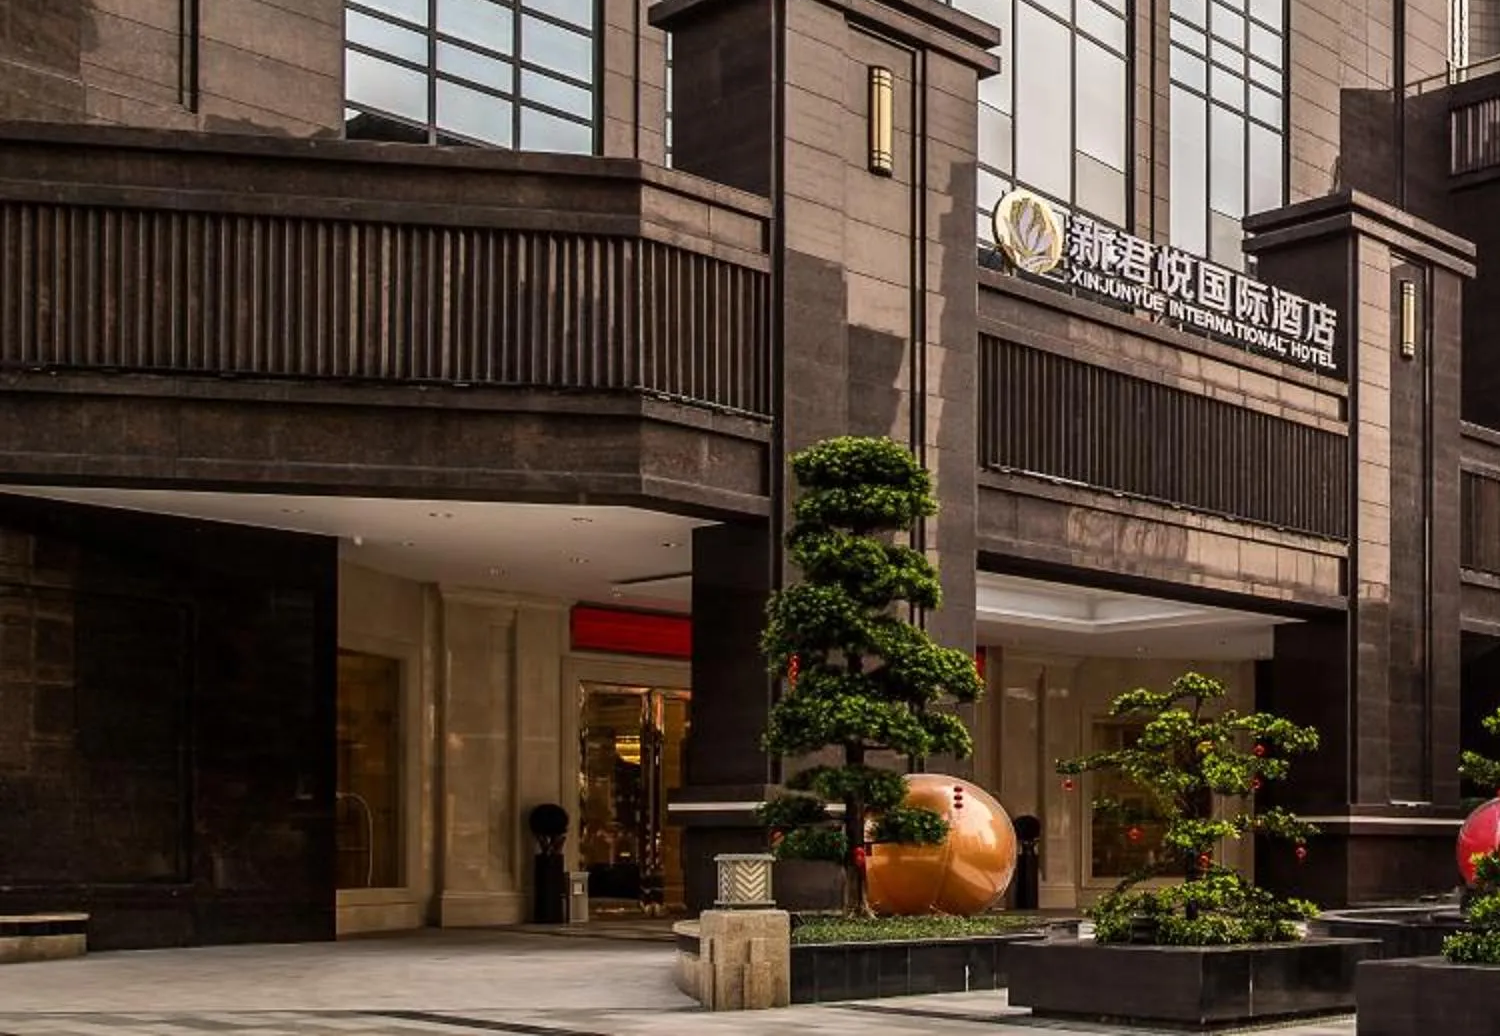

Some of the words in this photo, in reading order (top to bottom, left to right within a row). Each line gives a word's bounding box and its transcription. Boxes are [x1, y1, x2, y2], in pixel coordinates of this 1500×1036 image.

[1069, 215, 1337, 348] 新君悦国际酒店
[1071, 265, 1164, 312] XINJUNYUE
[1169, 300, 1289, 354] INTERNATIONAL
[1291, 341, 1337, 369] HOTEL
